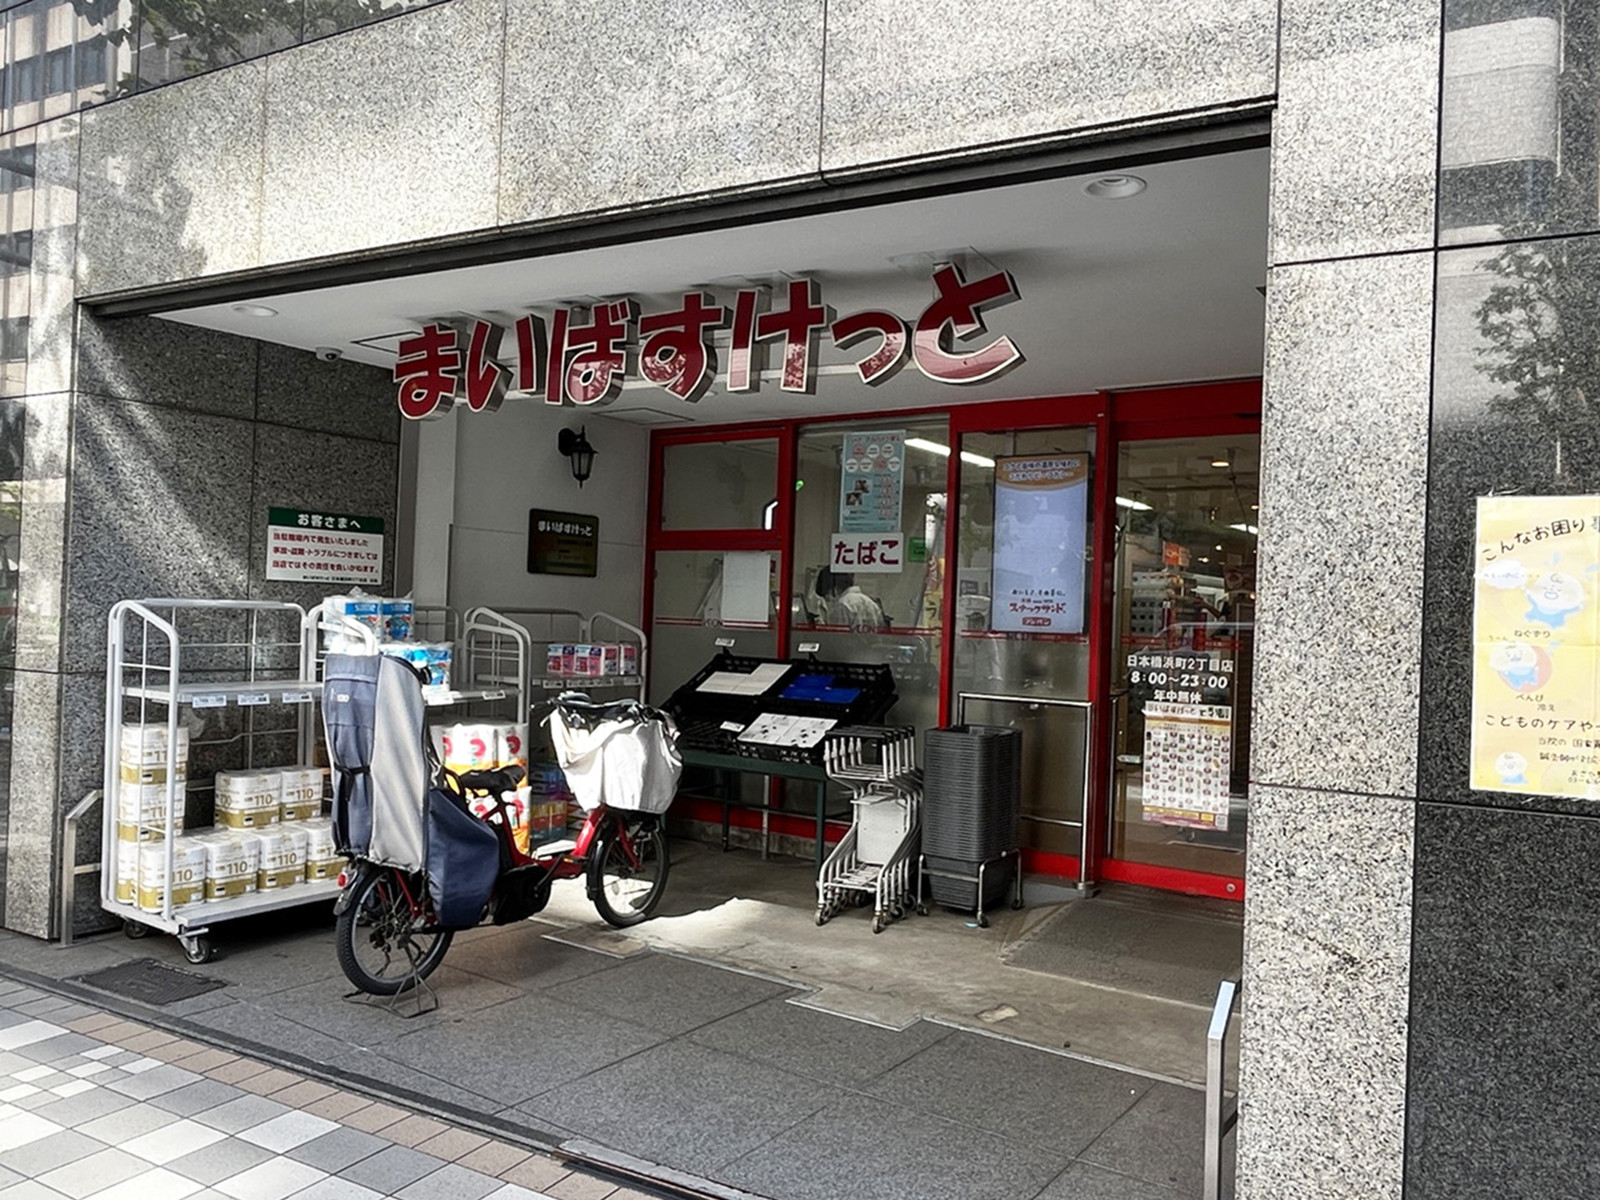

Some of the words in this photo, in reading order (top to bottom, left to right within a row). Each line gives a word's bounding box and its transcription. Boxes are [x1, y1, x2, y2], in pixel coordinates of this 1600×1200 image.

[394, 263, 1023, 420] まいばすけっと
[297, 513, 361, 529] お客さまへ
[834, 540, 900, 565] たばこ
[1009, 602, 1067, 614] スナックサンド
[1127, 655, 1235, 673] 日本橋浜町2丁目店
[1153, 689, 1202, 704] 年中無休
[254, 793, 273, 806] 110
[296, 788, 314, 800] 110
[276, 852, 297, 865] 110
[227, 861, 247, 874] 110
